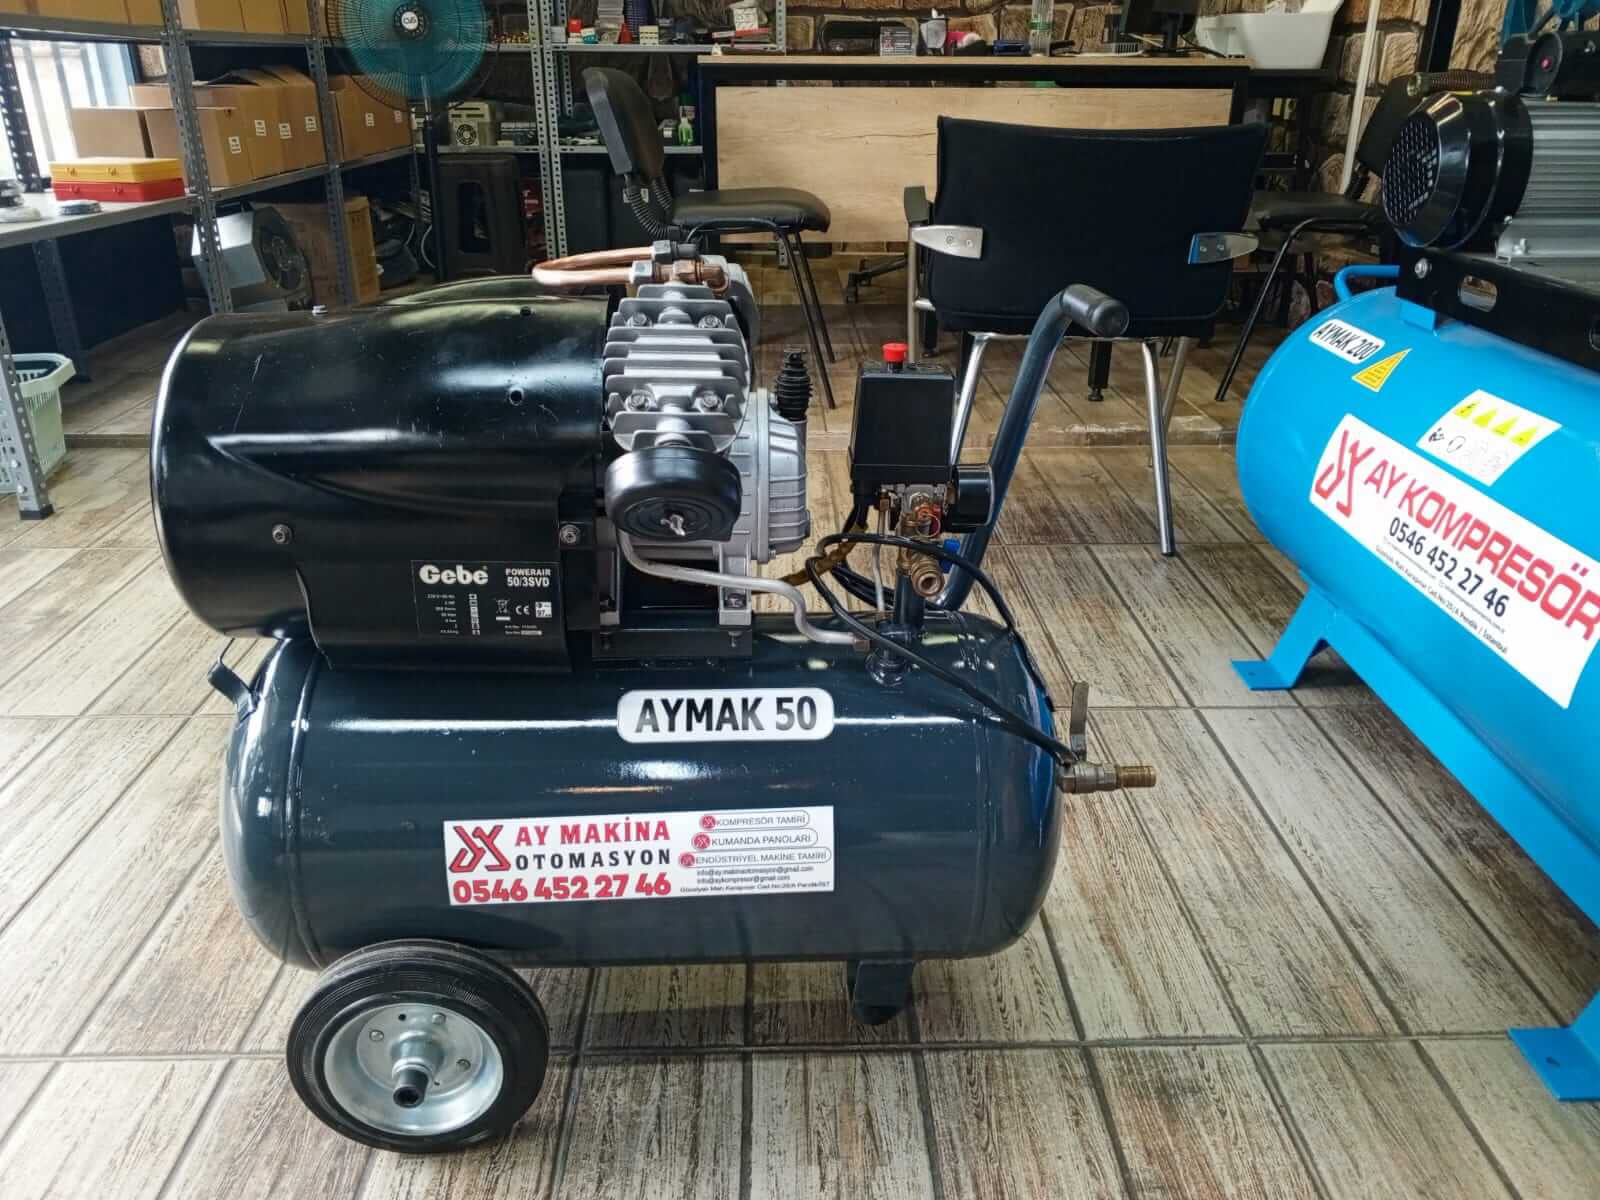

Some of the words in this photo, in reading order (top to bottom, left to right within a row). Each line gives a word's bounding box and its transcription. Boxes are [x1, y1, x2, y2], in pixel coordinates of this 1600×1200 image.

[1312, 322, 1361, 351] AYMAK
[1347, 339, 1380, 360] 200
[1364, 459, 1408, 499] AY
[1398, 478, 1600, 641] KOMPRESÖR
[419, 564, 489, 585] Gebe
[505, 568, 551, 577] POWERAIR
[1389, 516, 1427, 556] 0546
[1426, 546, 1459, 581] 452
[1458, 567, 1484, 595] 27
[1484, 587, 1510, 617] 46
[635, 697, 764, 733] AYMAK
[775, 696, 817, 731] 50
[514, 825, 550, 847] AY
[560, 816, 671, 845] MAKİNA
[717, 815, 774, 826] KOMPRESÖR
[711, 836, 761, 847] KUMANDA
[515, 849, 671, 870] OTOMASYON
[761, 851, 796, 863] MAKİNE
[453, 878, 528, 903] 0546
[534, 874, 589, 900] 452
[594, 874, 630, 898] 27
[634, 872, 672, 896] 46
